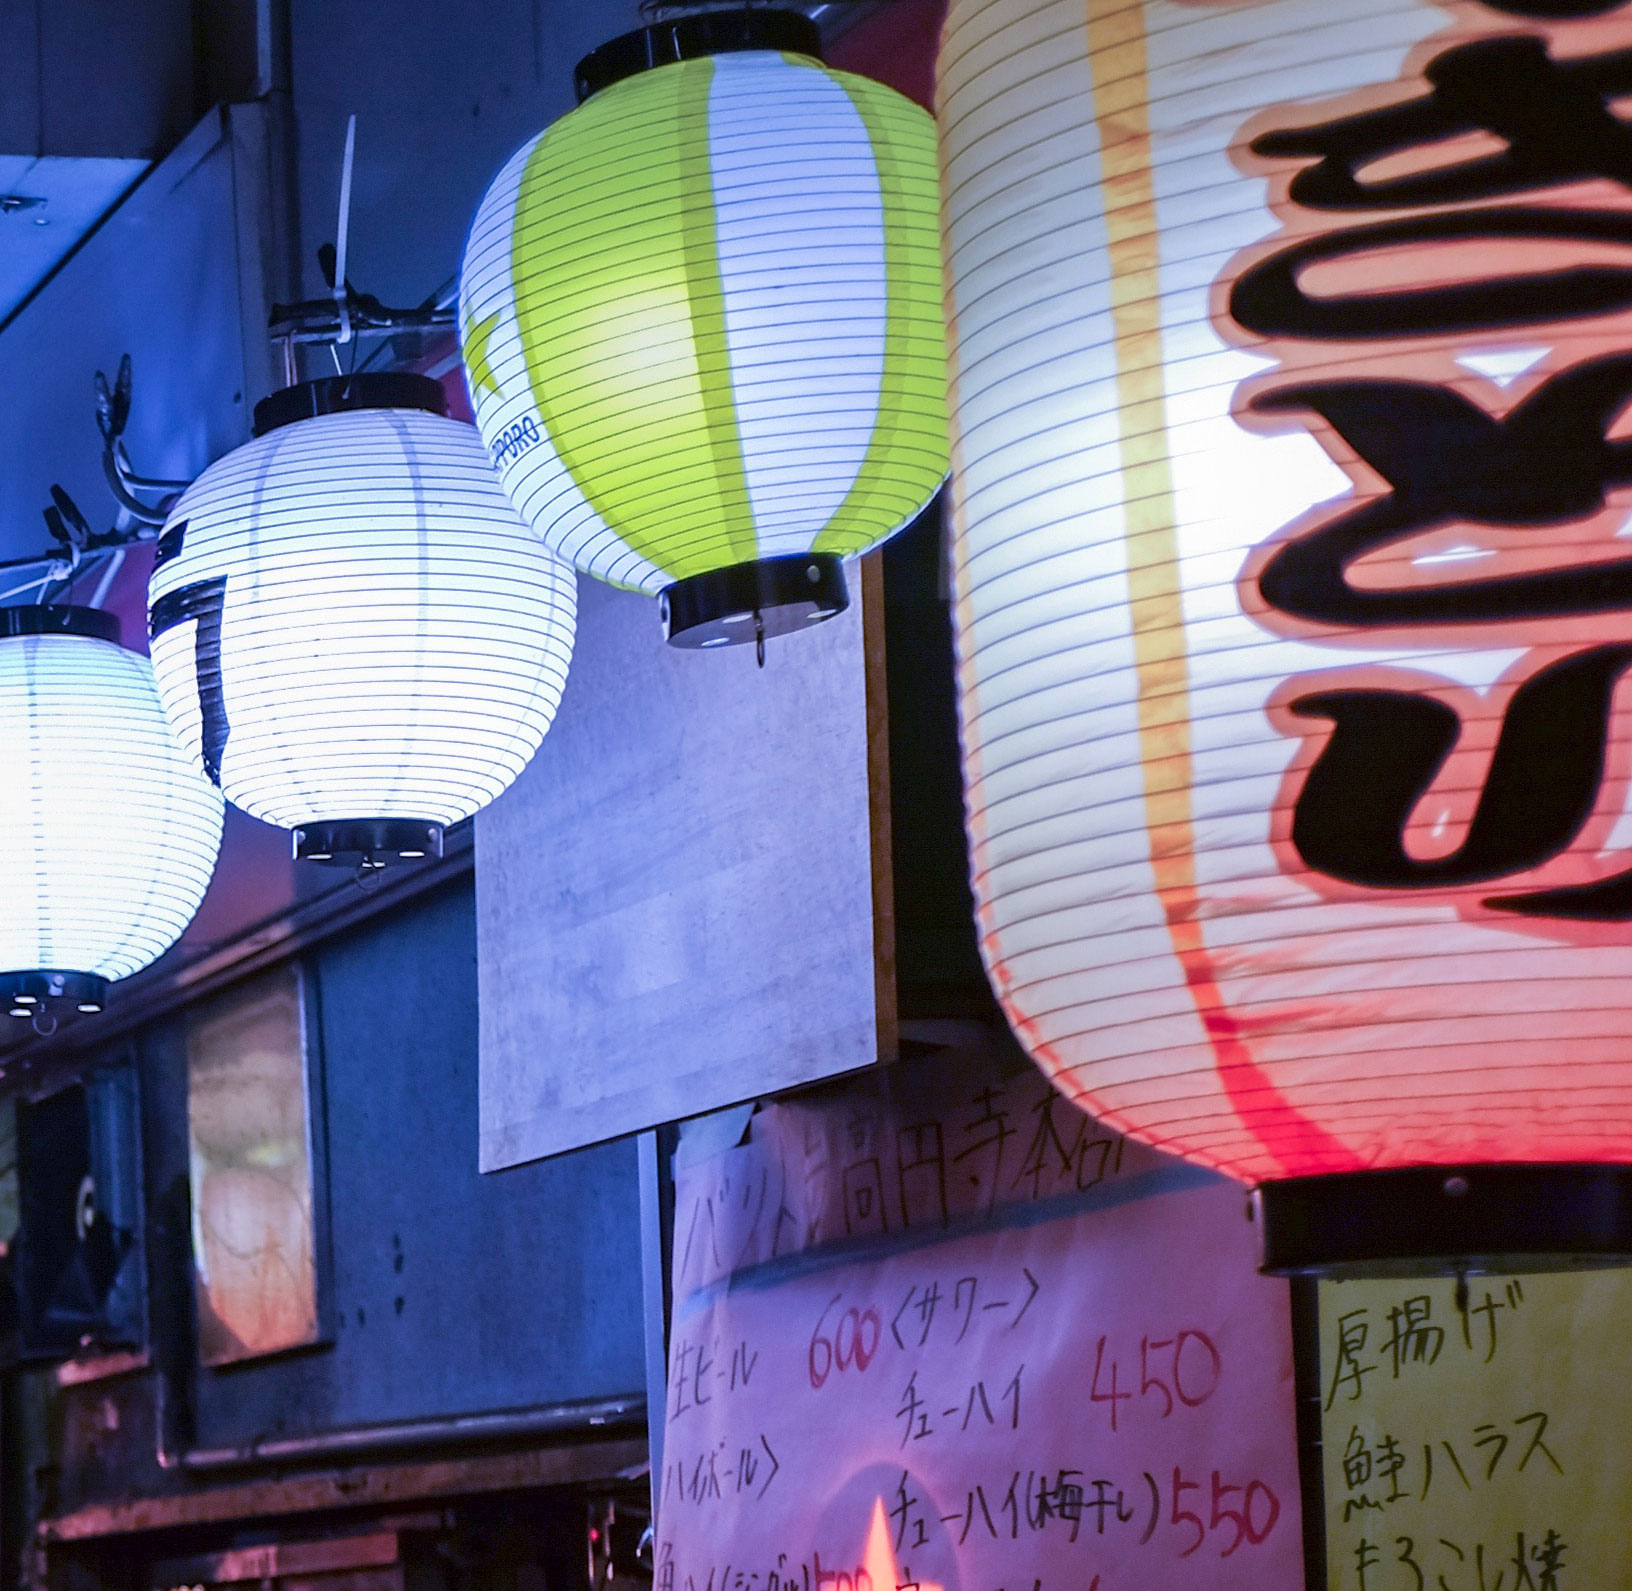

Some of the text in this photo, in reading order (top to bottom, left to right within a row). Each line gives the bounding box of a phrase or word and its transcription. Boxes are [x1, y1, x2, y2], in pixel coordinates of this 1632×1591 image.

[809, 1293, 881, 1390] 600
[896, 1330, 1221, 1451] チューハイ 450
[1324, 1279, 1525, 1413] 厚揚げ
[1172, 1466, 1281, 1558] 550
[1342, 1411, 1564, 1523] 鮭ハラス
